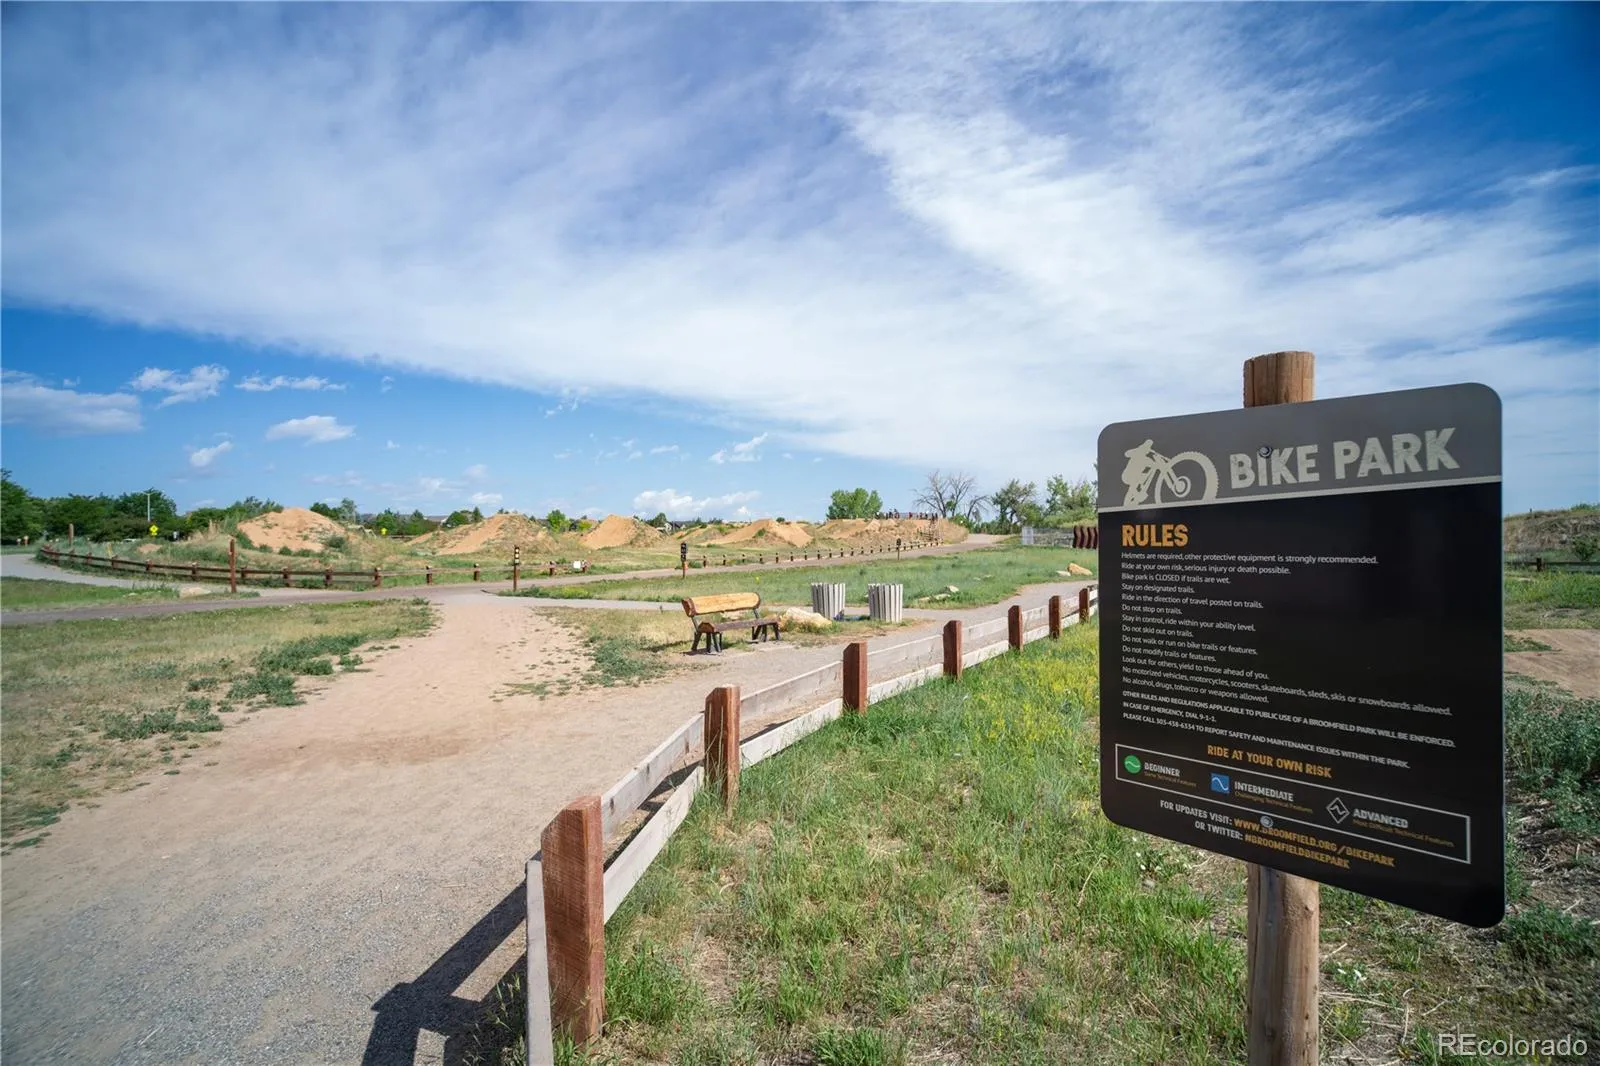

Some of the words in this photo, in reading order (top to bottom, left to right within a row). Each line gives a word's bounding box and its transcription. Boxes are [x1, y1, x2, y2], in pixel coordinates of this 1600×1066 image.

[1230, 444, 1320, 490] BIKE
[1333, 428, 1460, 480] PARK
[1122, 524, 1188, 546] RULES
[1203, 553, 1236, 562] protective
[1237, 554, 1276, 563] equipment
[1285, 554, 1316, 564] strongly
[1135, 574, 1148, 582] park
[1208, 564, 1227, 574] injury
[1122, 583, 1134, 592] Stay
[1144, 584, 1177, 593] designated
[1142, 606, 1155, 614] stop
[1154, 595, 1180, 603] direction
[1209, 599, 1232, 607] posted
[1122, 614, 1134, 623] Stay
[1178, 618, 1198, 626] within
[1215, 621, 1236, 632] ability
[1143, 648, 1163, 658] modify
[1186, 641, 1200, 649] bike
[1201, 643, 1218, 651] trails
[1122, 655, 1136, 664] Look
[1179, 662, 1194, 671] yield
[1203, 665, 1222, 674] those
[1223, 667, 1244, 676] ahead
[1132, 668, 1162, 677] motorized
[1330, 692, 1346, 702] skis
[1358, 697, 1411, 710] snowboards
[1174, 683, 1198, 693] tobacco
[1208, 689, 1238, 699] weapons
[1123, 690, 1140, 699] OTHER
[1141, 693, 1158, 701] RULES
[1171, 698, 1209, 709] REGULATIONS
[1209, 703, 1244, 715] APPLICABLE
[1255, 710, 1278, 720] PUBLIC
[1279, 713, 1292, 722] USE
[1292, 715, 1302, 724] OF
[1309, 718, 1355, 732] BROOMFIELD
[1356, 725, 1377, 735] PARK
[1376, 728, 1397, 738] WILL
[1397, 731, 1408, 740] BE
[1185, 711, 1199, 719] DIAL
[1123, 712, 1142, 721] PLEASE
[1143, 716, 1156, 724] CALL
[1205, 726, 1228, 736] REPORT
[1228, 730, 1252, 740] SAFETY
[1251, 734, 1266, 743] AND
[1266, 736, 1315, 752] MAINTENANCE
[1316, 745, 1341, 756] ISSUES
[1341, 749, 1370, 761] WITHIN
[1370, 754, 1386, 764] THE
[1144, 762, 1180, 777] BEGINNER
[1207, 745, 1229, 758] RIDE
[1232, 750, 1243, 760] AT
[1246, 752, 1273, 767] YOUR
[1276, 758, 1303, 772] OWN
[1306, 763, 1332, 778] RISK
[1234, 781, 1294, 802] INTERMEDIATE
[1160, 800, 1173, 810] FOR
[1176, 804, 1207, 818] UPDATES
[1210, 812, 1232, 825] VISIT:
[1353, 808, 1408, 828] ADVANCED
[1195, 821, 1205, 830] OR
[1208, 823, 1243, 840] TWITTER:
